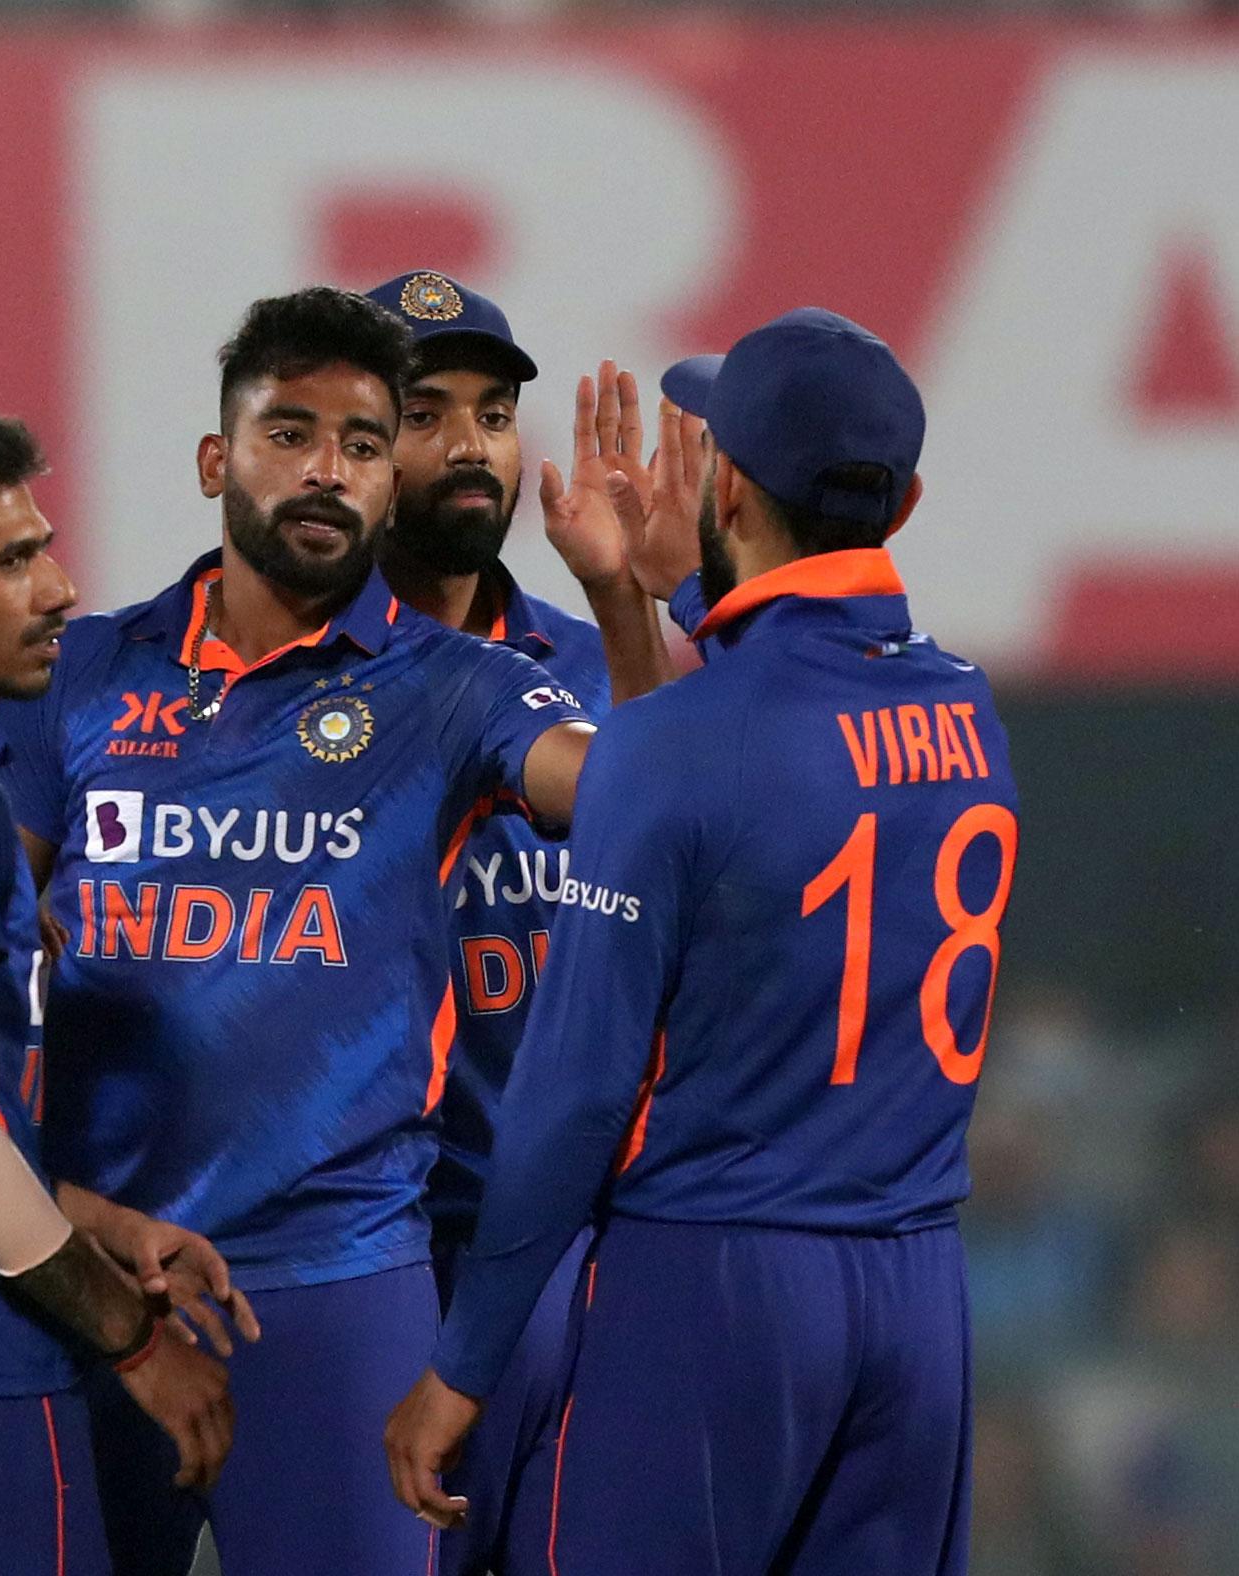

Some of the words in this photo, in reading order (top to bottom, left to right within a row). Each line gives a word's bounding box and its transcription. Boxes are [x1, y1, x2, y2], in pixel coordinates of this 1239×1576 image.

[104, 739, 180, 759] KILLER
[836, 702, 990, 789] VIRAT
[151, 803, 365, 864] BYJU'S
[76, 878, 350, 968] INDIA
[562, 877, 642, 923] BYJU'S
[800, 802, 1020, 1086] 18
